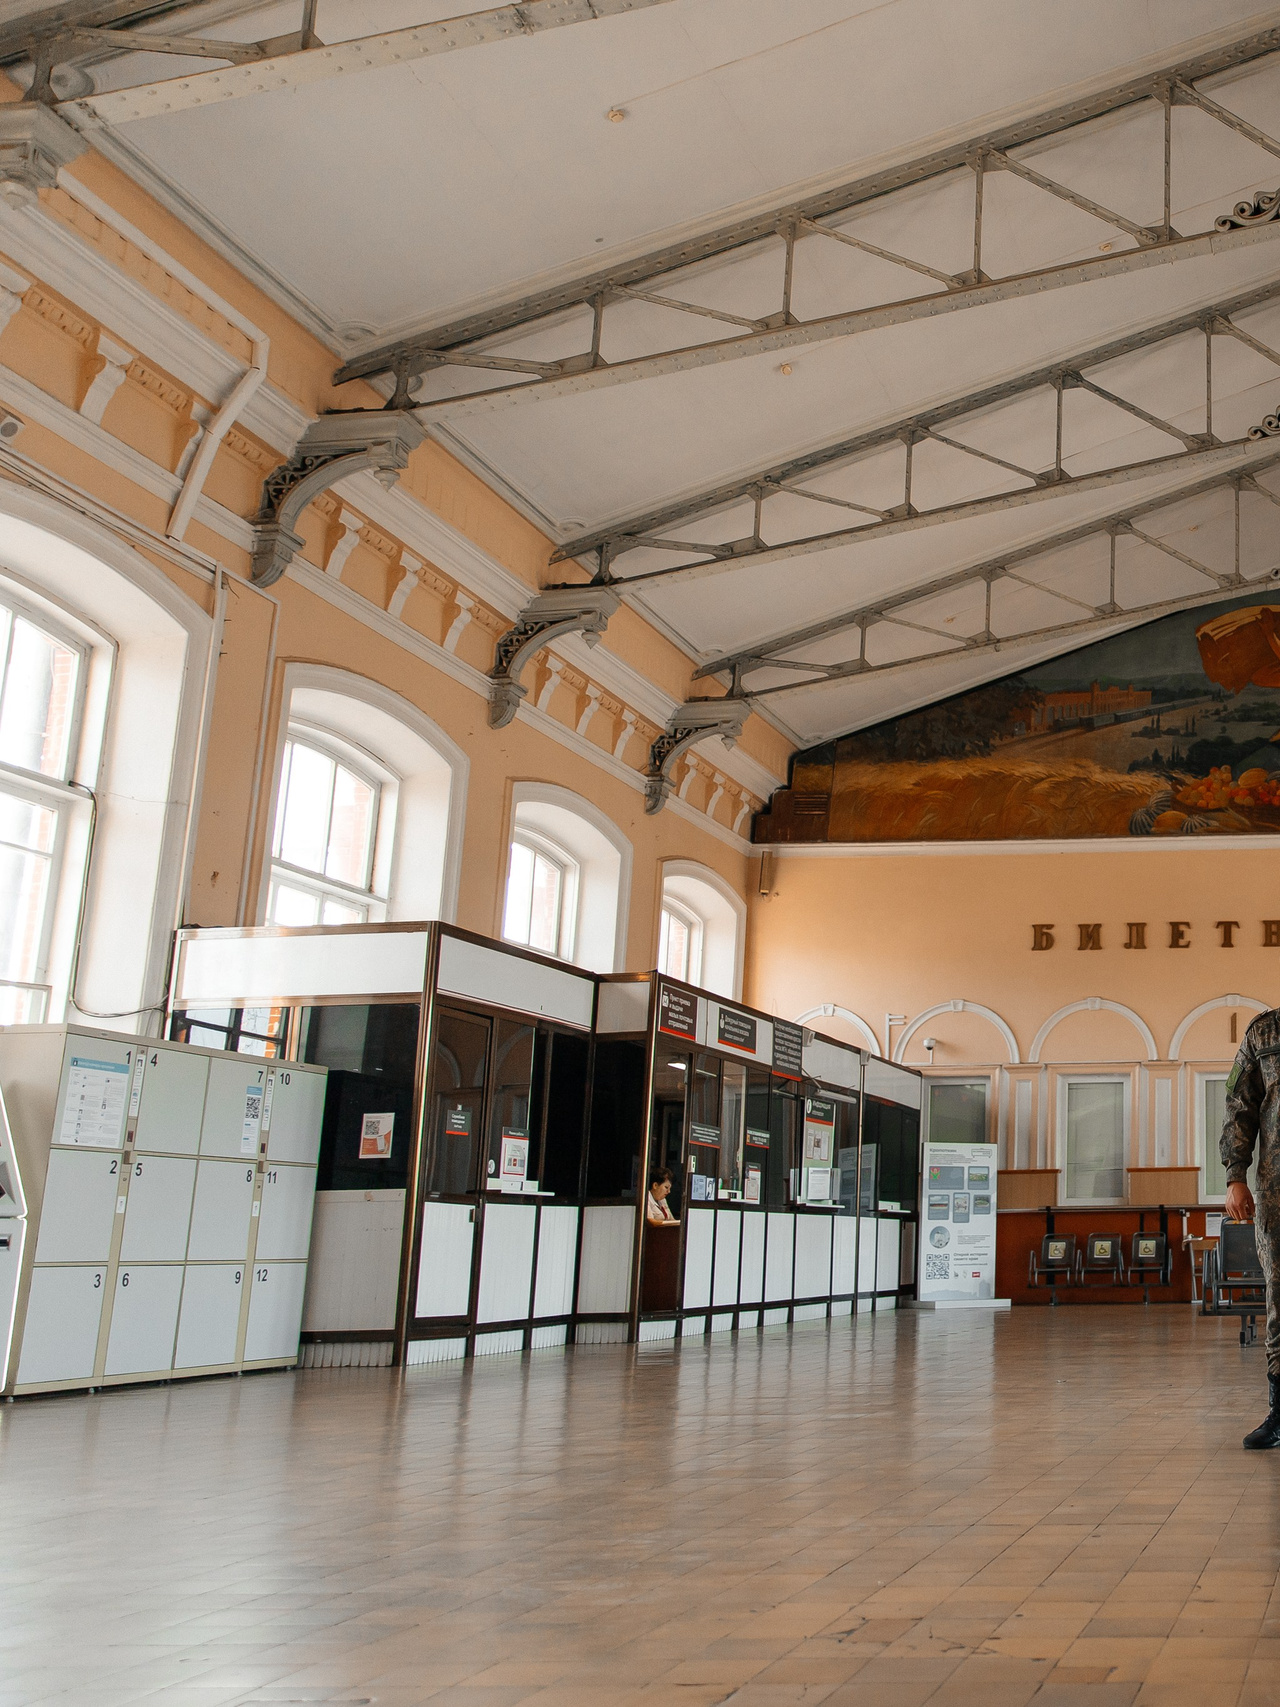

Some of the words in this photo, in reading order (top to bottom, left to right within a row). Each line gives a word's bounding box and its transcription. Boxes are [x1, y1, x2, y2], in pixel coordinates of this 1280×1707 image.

[1230, 1012, 1237, 1044] 1
[126, 1051, 132, 1065] 1
[150, 1053, 158, 1067] 4
[257, 1071, 264, 1083] 7
[280, 1073, 291, 1086] 10
[109, 1160, 118, 1175] 2
[135, 1162, 143, 1177] 5
[246, 1169, 253, 1183] 8
[267, 1171, 278, 1184] 11
[93, 1273, 101, 1288] 3
[122, 1272, 130, 1287] 6
[234, 1271, 241, 1284] 9
[256, 1269, 268, 1282] 12
